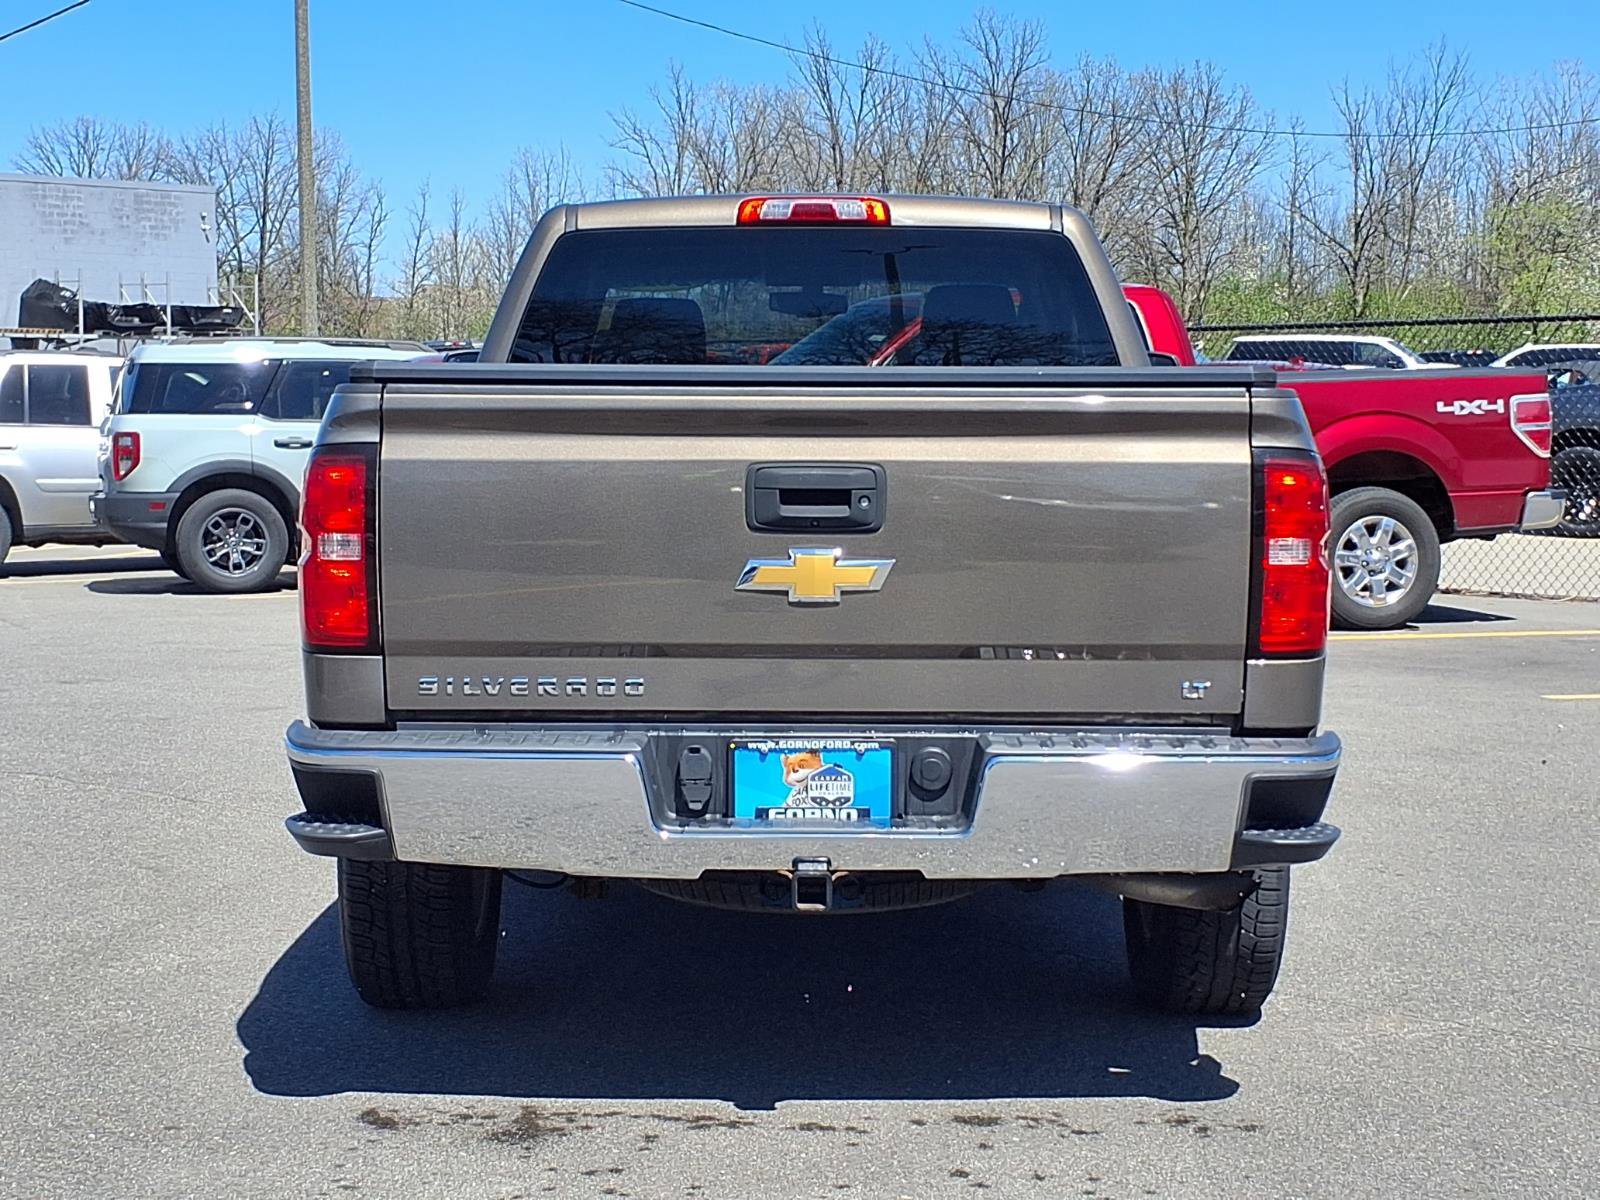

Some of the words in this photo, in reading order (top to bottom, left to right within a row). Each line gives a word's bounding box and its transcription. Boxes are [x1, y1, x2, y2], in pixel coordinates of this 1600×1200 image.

[418, 677, 645, 696] SILVERADO
[1181, 681, 1211, 699] LT
[809, 783, 852, 792] LIFETIME
